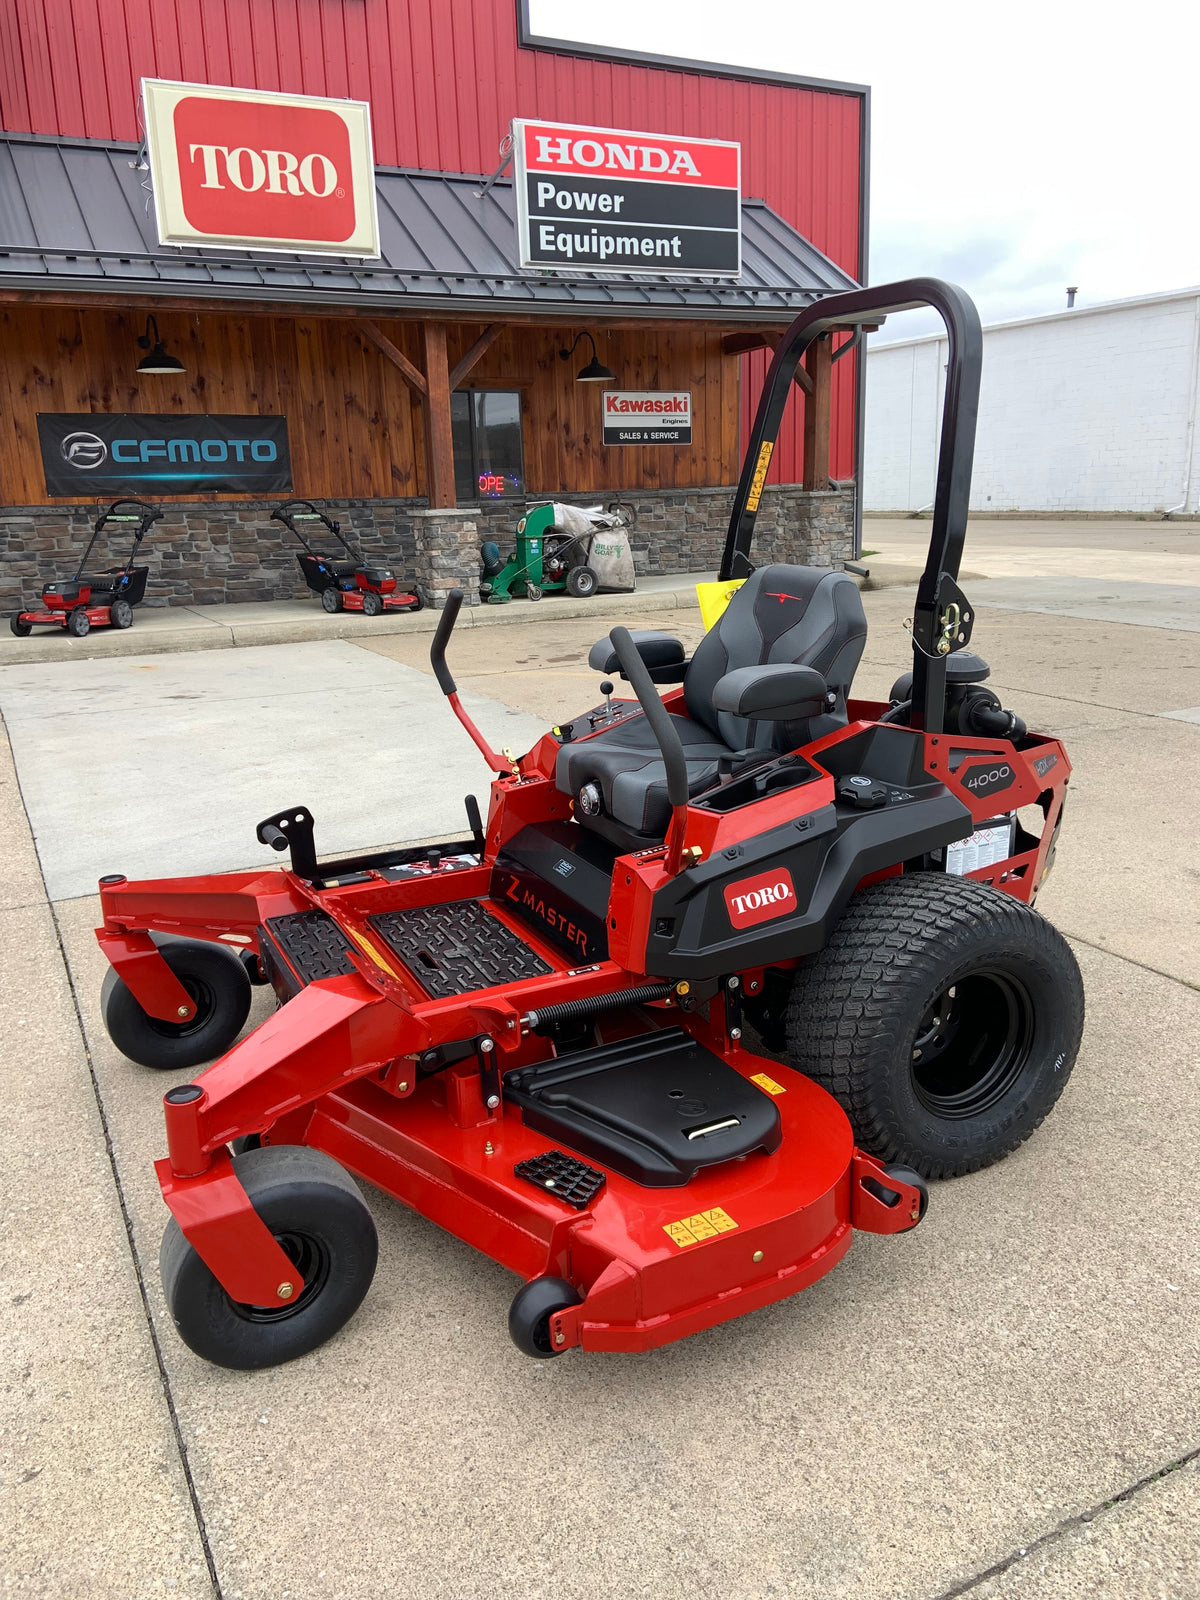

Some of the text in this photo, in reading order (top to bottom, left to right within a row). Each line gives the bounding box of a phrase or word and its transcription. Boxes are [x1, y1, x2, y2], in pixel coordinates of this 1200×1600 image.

[189, 143, 338, 198] TORO
[535, 135, 701, 177] HONDA
[537, 181, 625, 213] Power
[539, 225, 682, 259] Equipment
[606, 396, 688, 412] Kawasaki
[111, 439, 277, 463] CFMOTO
[619, 432, 641, 440] SALES
[650, 431, 679, 439] SERVICE
[967, 766, 1010, 789] 4000
[731, 882, 789, 915] TORO
[506, 874, 588, 957] Z MASTER
